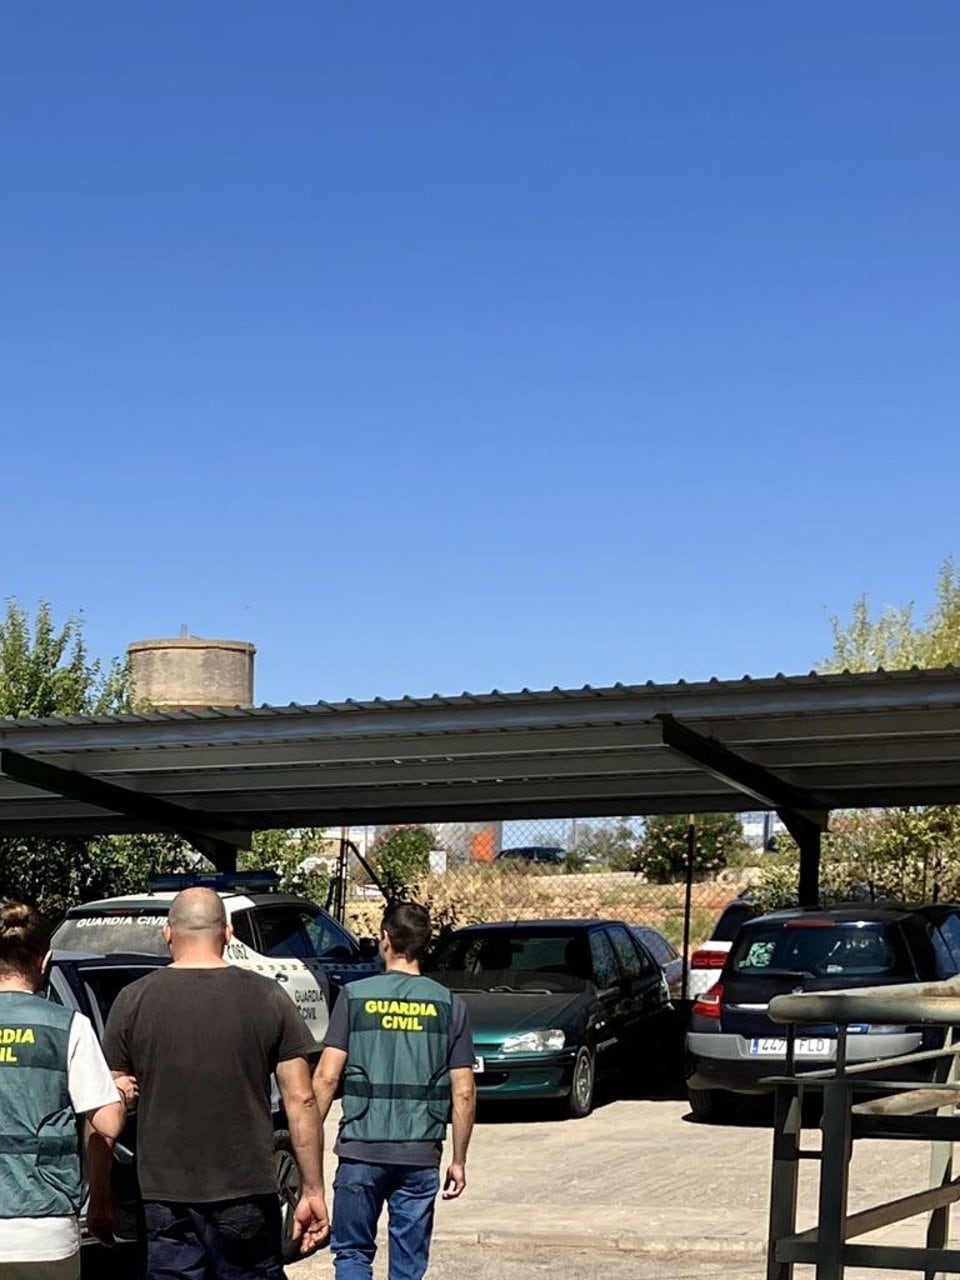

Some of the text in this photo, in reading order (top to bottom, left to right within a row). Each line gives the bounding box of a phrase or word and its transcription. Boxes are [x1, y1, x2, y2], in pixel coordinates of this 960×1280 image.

[76, 916, 133, 928] GUARDIA
[295, 990, 323, 1002] GUARDIA
[365, 1001, 437, 1016] GUARDIA
[382, 1015, 423, 1030] CIVIL
[761, 1040, 787, 1051] 447
